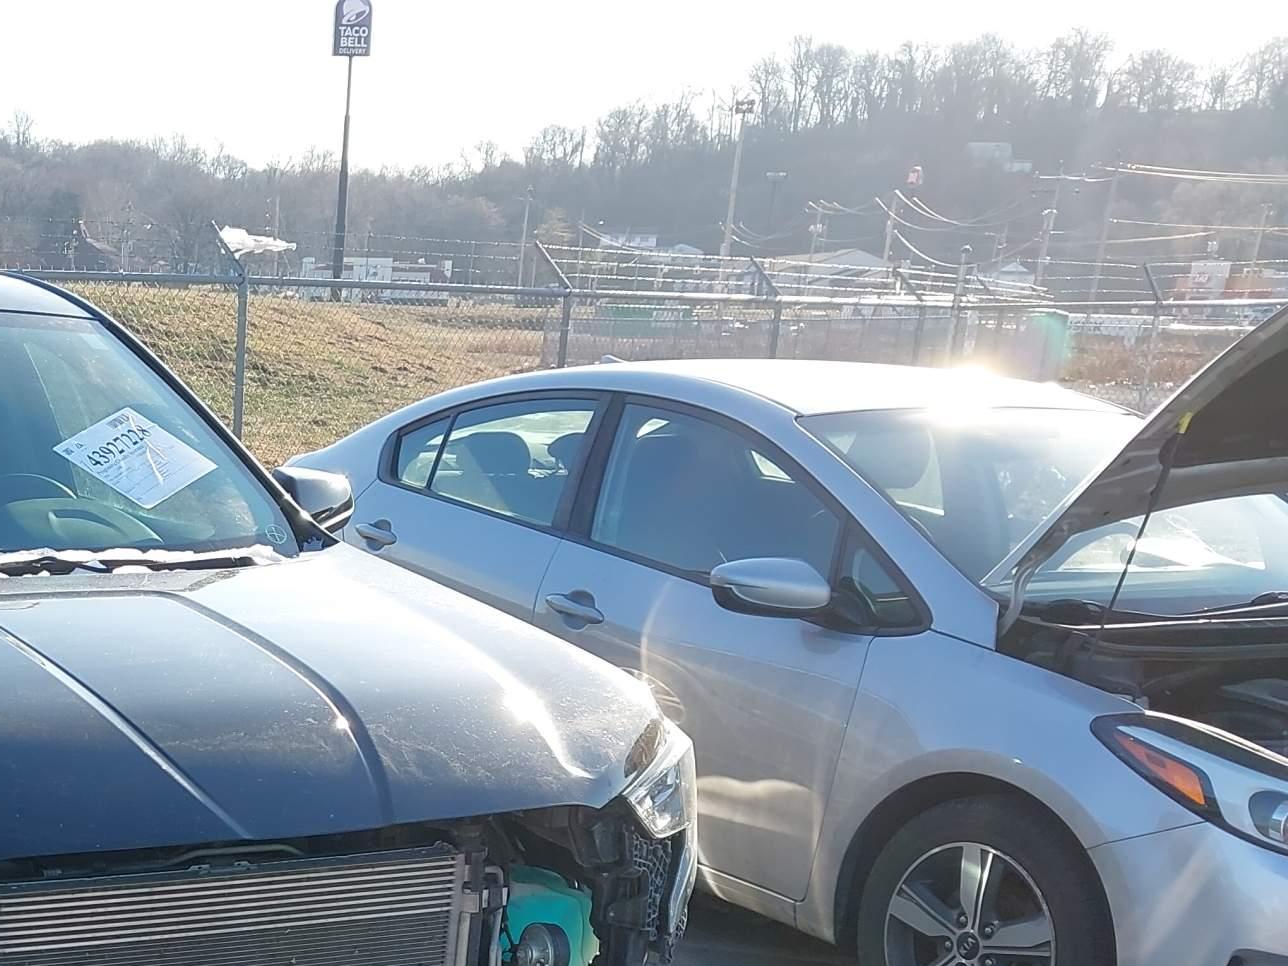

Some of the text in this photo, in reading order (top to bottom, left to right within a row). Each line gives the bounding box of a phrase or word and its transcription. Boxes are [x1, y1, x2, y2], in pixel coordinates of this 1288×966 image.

[338, 26, 368, 37] TACO
[340, 37, 367, 47] BELL
[86, 424, 153, 467] 43927228
